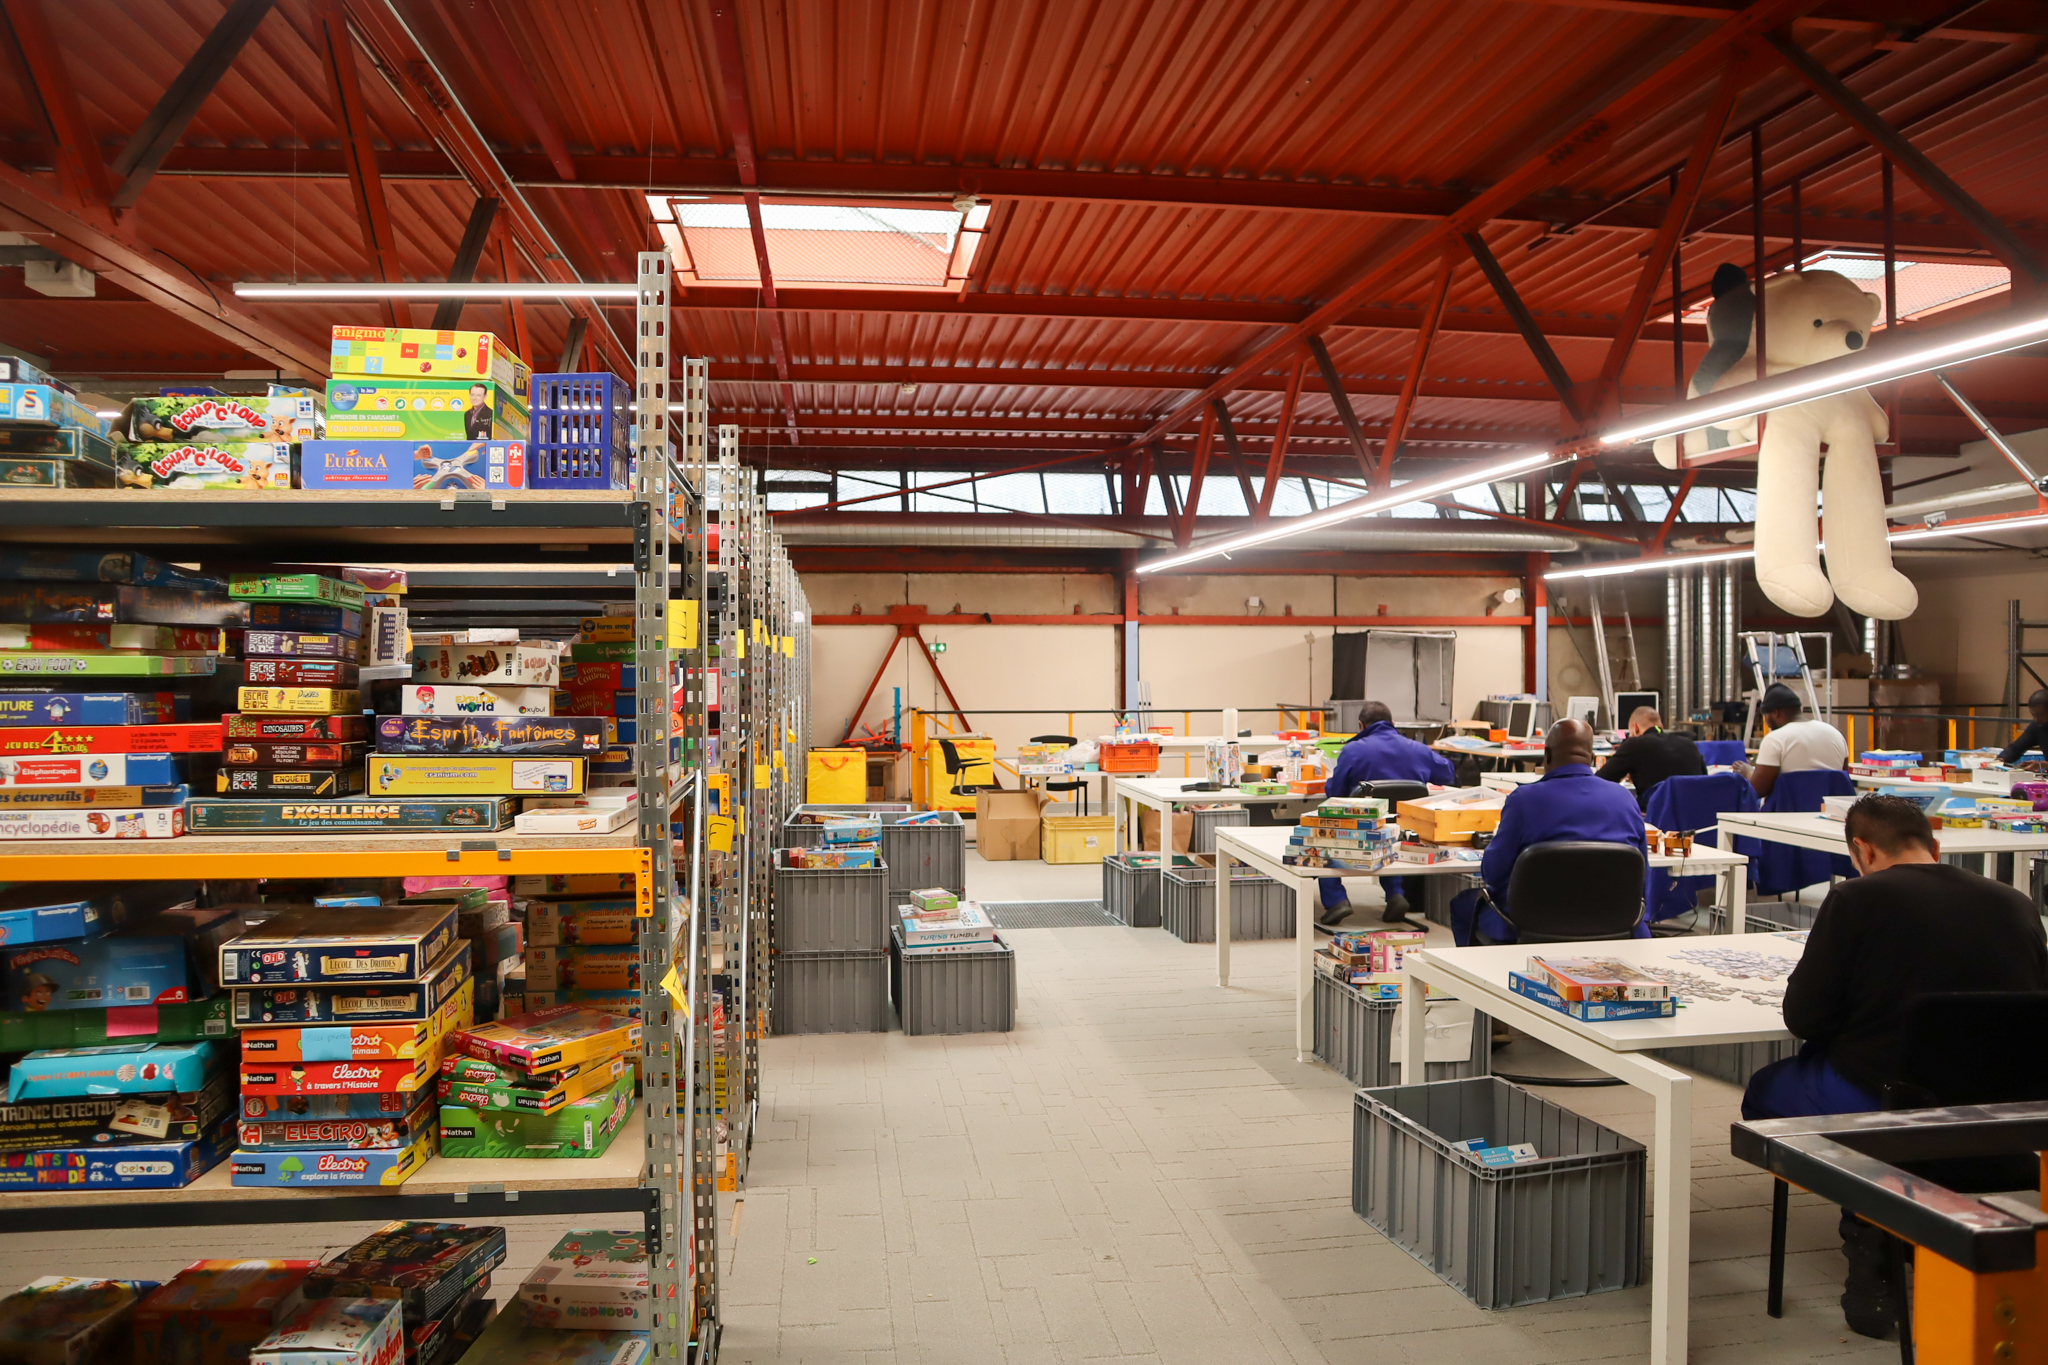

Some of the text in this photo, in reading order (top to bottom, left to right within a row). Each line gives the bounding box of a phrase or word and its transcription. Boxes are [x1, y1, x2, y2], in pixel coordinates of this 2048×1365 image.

[333, 327, 385, 340] énigmo
[597, 622, 630, 631] farm snap
[15, 658, 76, 672] EASY FOOT
[582, 666, 606, 675] Formes
[577, 672, 610, 686] Couleurs
[457, 702, 494, 712] world
[263, 725, 304, 733] DINOSAURES
[410, 719, 478, 746] Esprit
[492, 719, 576, 745] Fantômes
[41, 731, 61, 753] 4
[22, 767, 77, 777] Éléphantaquiz
[275, 774, 309, 783] ENQUÊTE
[13, 791, 82, 803] écureuils
[281, 805, 401, 819] EXCELLENCE
[38, 906, 78, 917] Ravensburger
[536, 908, 549, 916] MB
[588, 909, 611, 917] famille
[612, 908, 621, 916] de
[622, 907, 632, 916] M.
[534, 951, 546, 960] MB
[585, 953, 609, 961] famille
[609, 953, 619, 961] de
[620, 953, 629, 961] M.
[356, 960, 368, 968] DES
[370, 959, 396, 968] DRUIDES
[366, 1000, 379, 1008] DES
[381, 998, 407, 1008] DRUIDES
[534, 997, 545, 1005] MB
[585, 998, 608, 1006] famille
[620, 997, 629, 1005] M.
[1617, 1007, 1645, 1016] OBSERVATION
[248, 1041, 275, 1049] Nathan
[537, 1054, 560, 1065] Nathan
[27, 1073, 53, 1082] Explore
[64, 1071, 87, 1079] CORPS
[88, 1069, 115, 1078] HUMAIN
[332, 1064, 380, 1079] Electro
[463, 1068, 497, 1084] Electro
[458, 1093, 490, 1107] Electro
[518, 1098, 541, 1107] Nathan
[548, 1095, 564, 1107] Nathan
[285, 1123, 366, 1141] ELECTRO
[68, 1154, 86, 1168] DU
[318, 1155, 364, 1172] Electro
[37, 1169, 86, 1184] MONDE
[301, 1173, 329, 1181] explore
[339, 1172, 364, 1180] France
